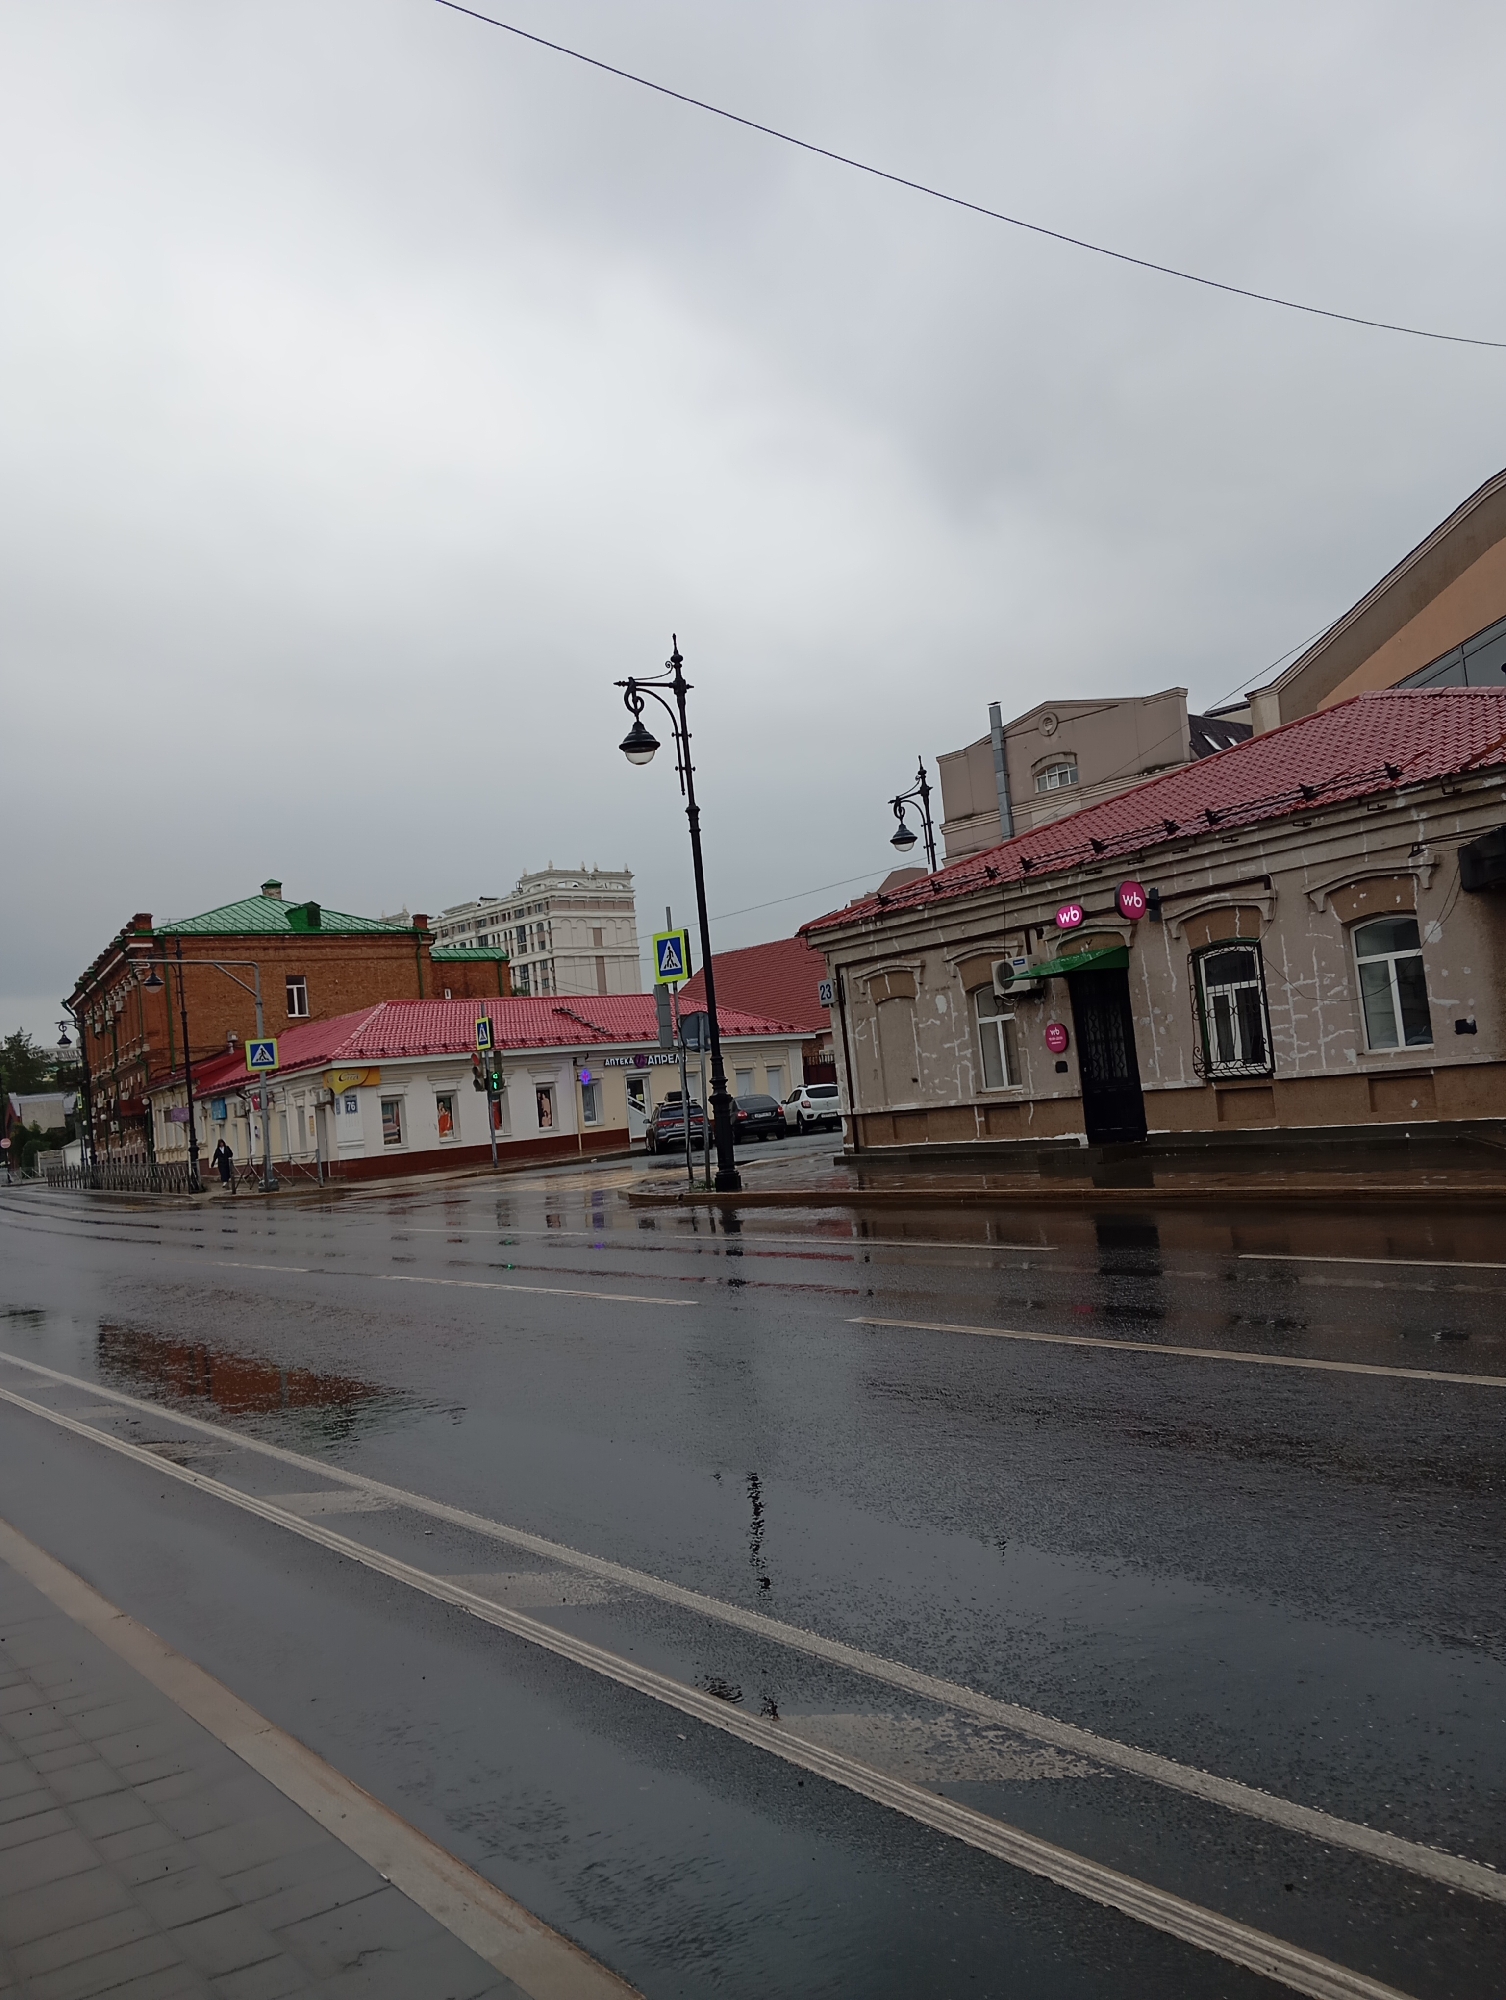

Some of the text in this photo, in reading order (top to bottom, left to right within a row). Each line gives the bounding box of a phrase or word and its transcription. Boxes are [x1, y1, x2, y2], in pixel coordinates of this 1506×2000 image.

[1122, 892, 1143, 908] wb
[1059, 907, 1079, 924] wb
[820, 984, 832, 1000] 23
[605, 1058, 634, 1066] АПТЕКА
[346, 1102, 356, 1110] 76
